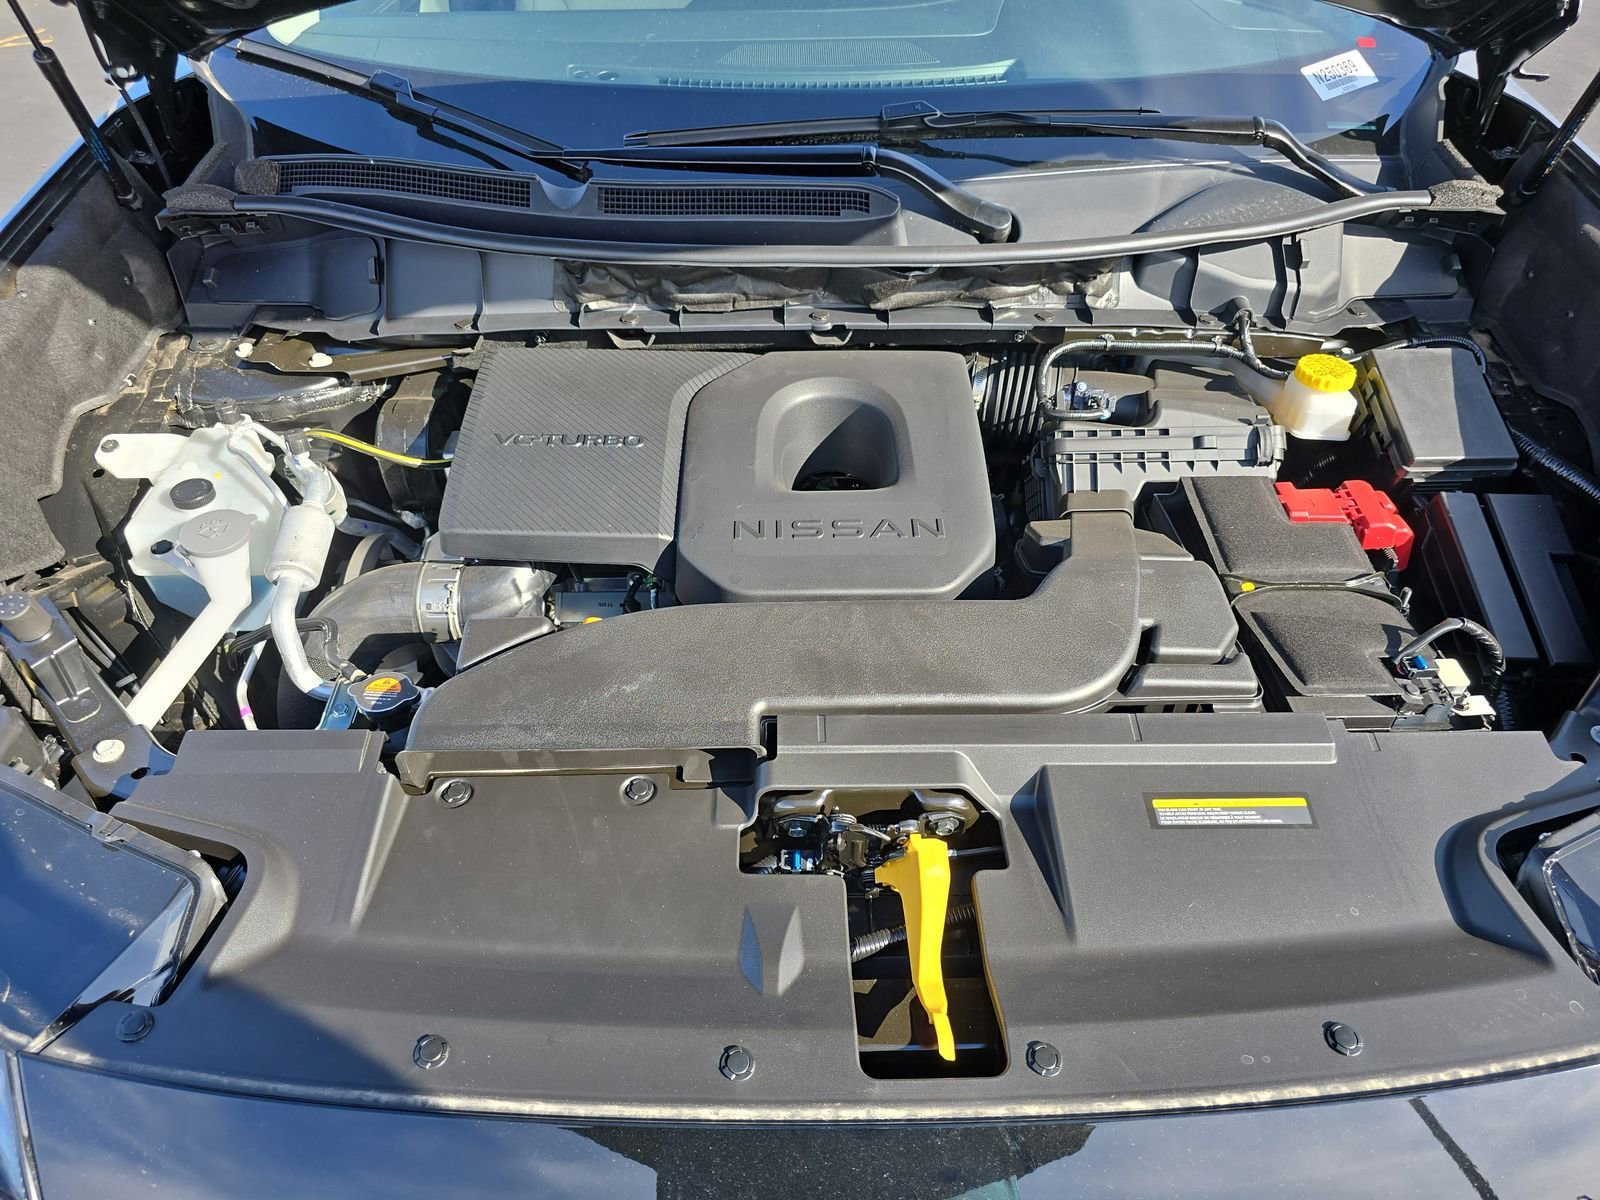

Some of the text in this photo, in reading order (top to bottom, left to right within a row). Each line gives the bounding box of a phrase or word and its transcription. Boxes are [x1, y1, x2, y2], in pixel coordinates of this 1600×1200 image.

[1312, 59, 1358, 85] N250369
[494, 433, 645, 448] VC-TURBO
[733, 518, 946, 540] NISSAN
